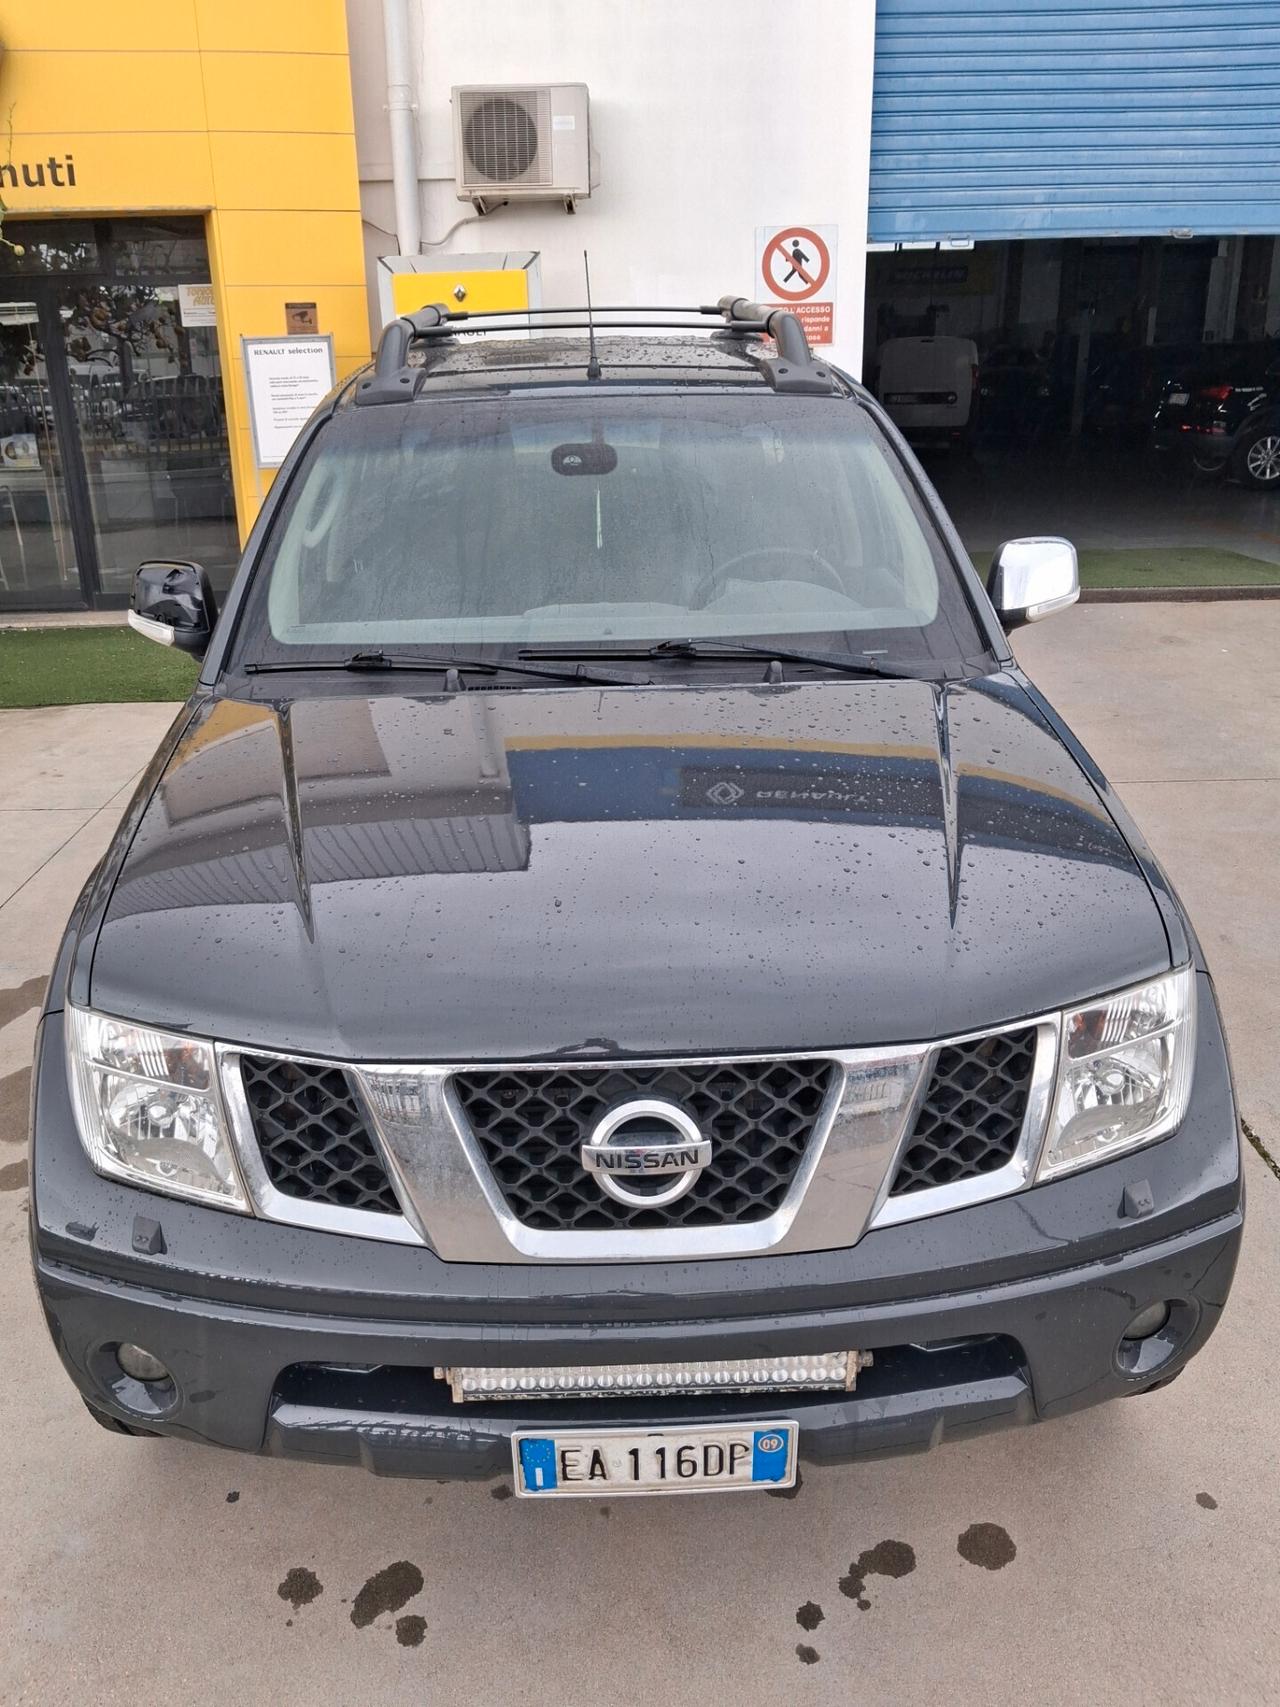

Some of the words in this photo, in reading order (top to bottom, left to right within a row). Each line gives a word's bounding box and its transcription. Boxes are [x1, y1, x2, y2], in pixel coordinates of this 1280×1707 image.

[0, 154, 76, 187] nuti
[789, 306, 831, 315] L'ACCESSO
[801, 315, 830, 324] risponde
[253, 348, 285, 356] RENAULT
[288, 346, 323, 354] selection
[596, 1149, 699, 1168] NISSAN
[762, 1437, 777, 1449] 09
[560, 1448, 608, 1481] EA
[628, 1441, 750, 1481] 116DP
